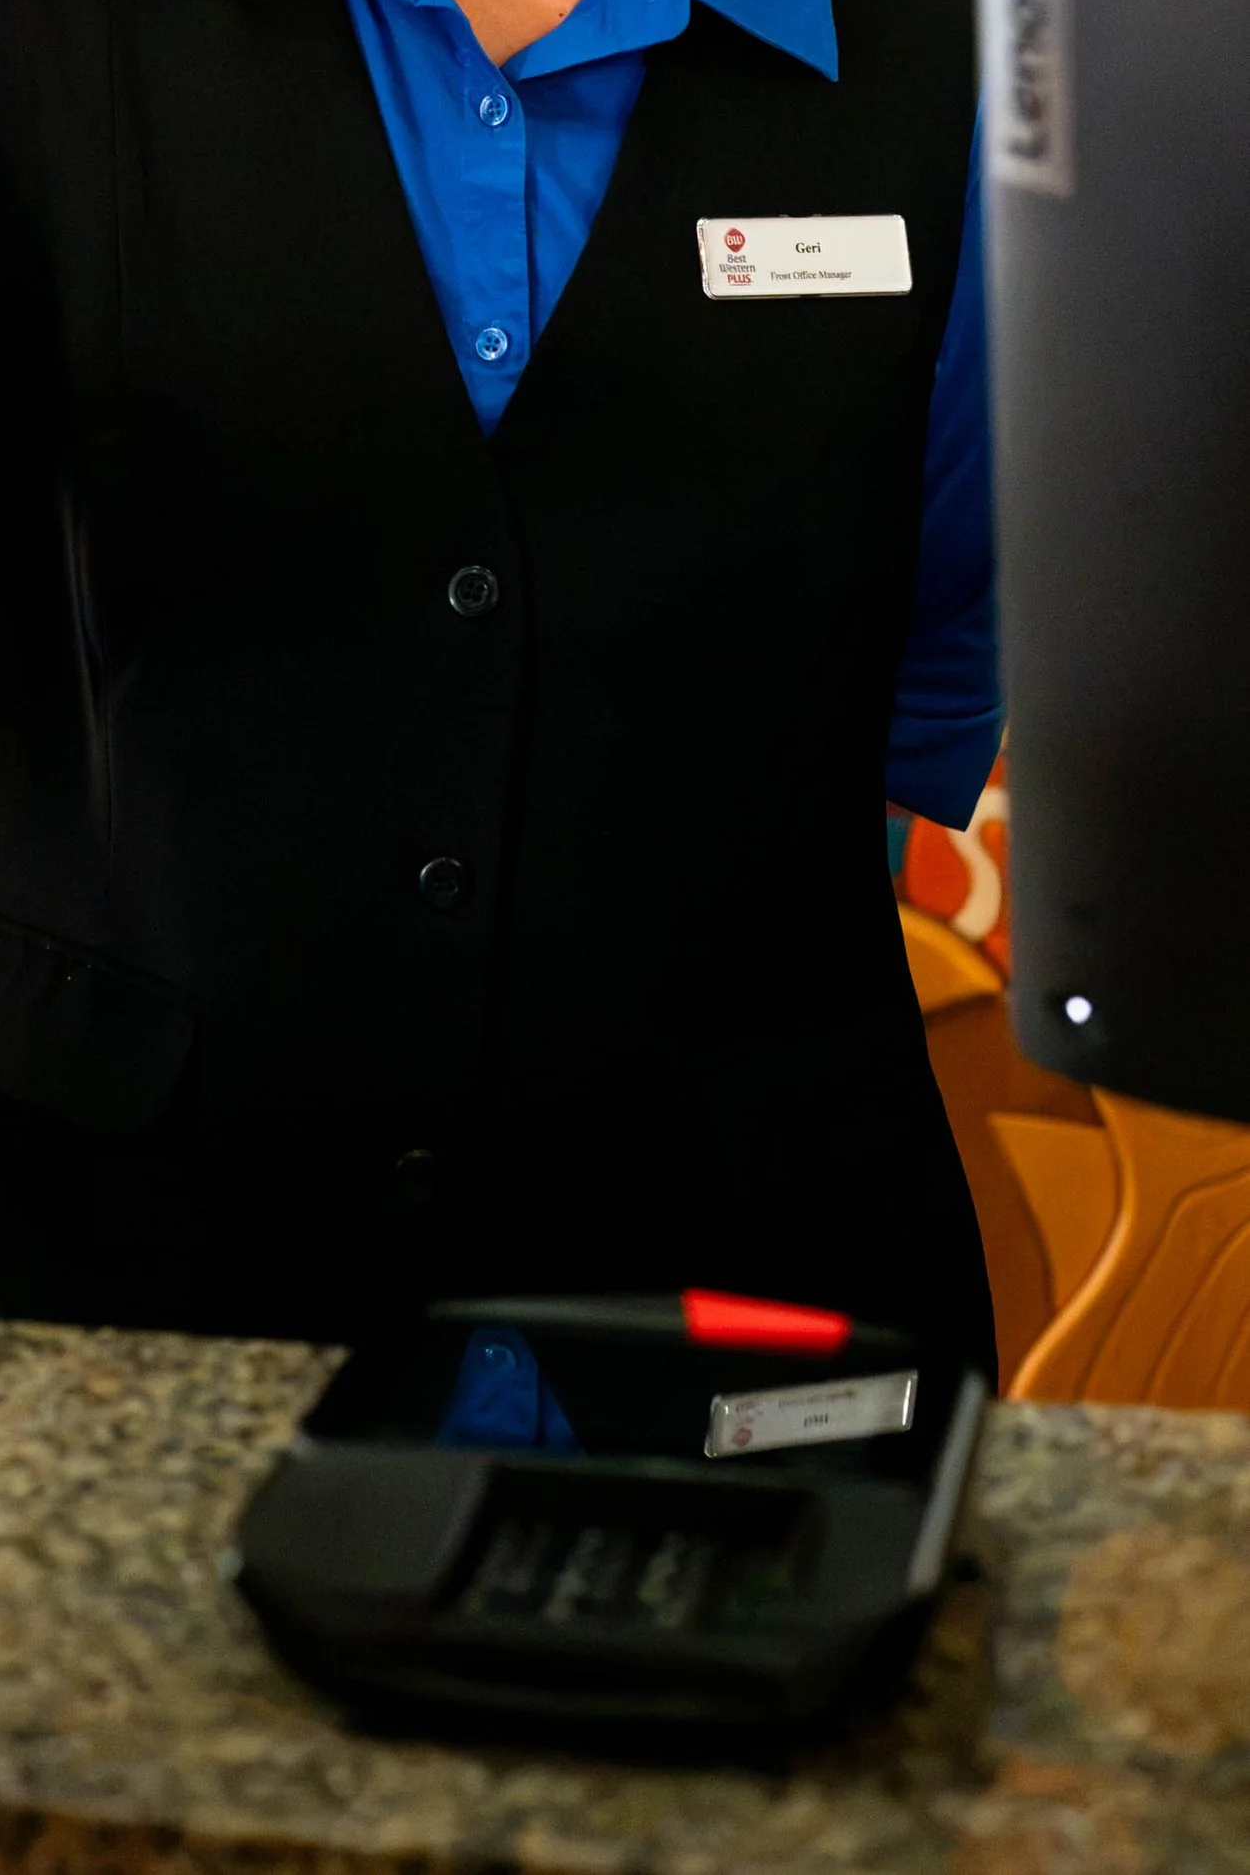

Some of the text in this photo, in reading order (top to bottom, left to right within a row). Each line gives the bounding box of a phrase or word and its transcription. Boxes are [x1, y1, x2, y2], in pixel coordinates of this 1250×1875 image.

[795, 242, 821, 254] Geri
[727, 254, 747, 263] Best
[719, 263, 756, 273] Western
[727, 274, 752, 283] PLUS
[770, 271, 852, 281] Front Office Manager
